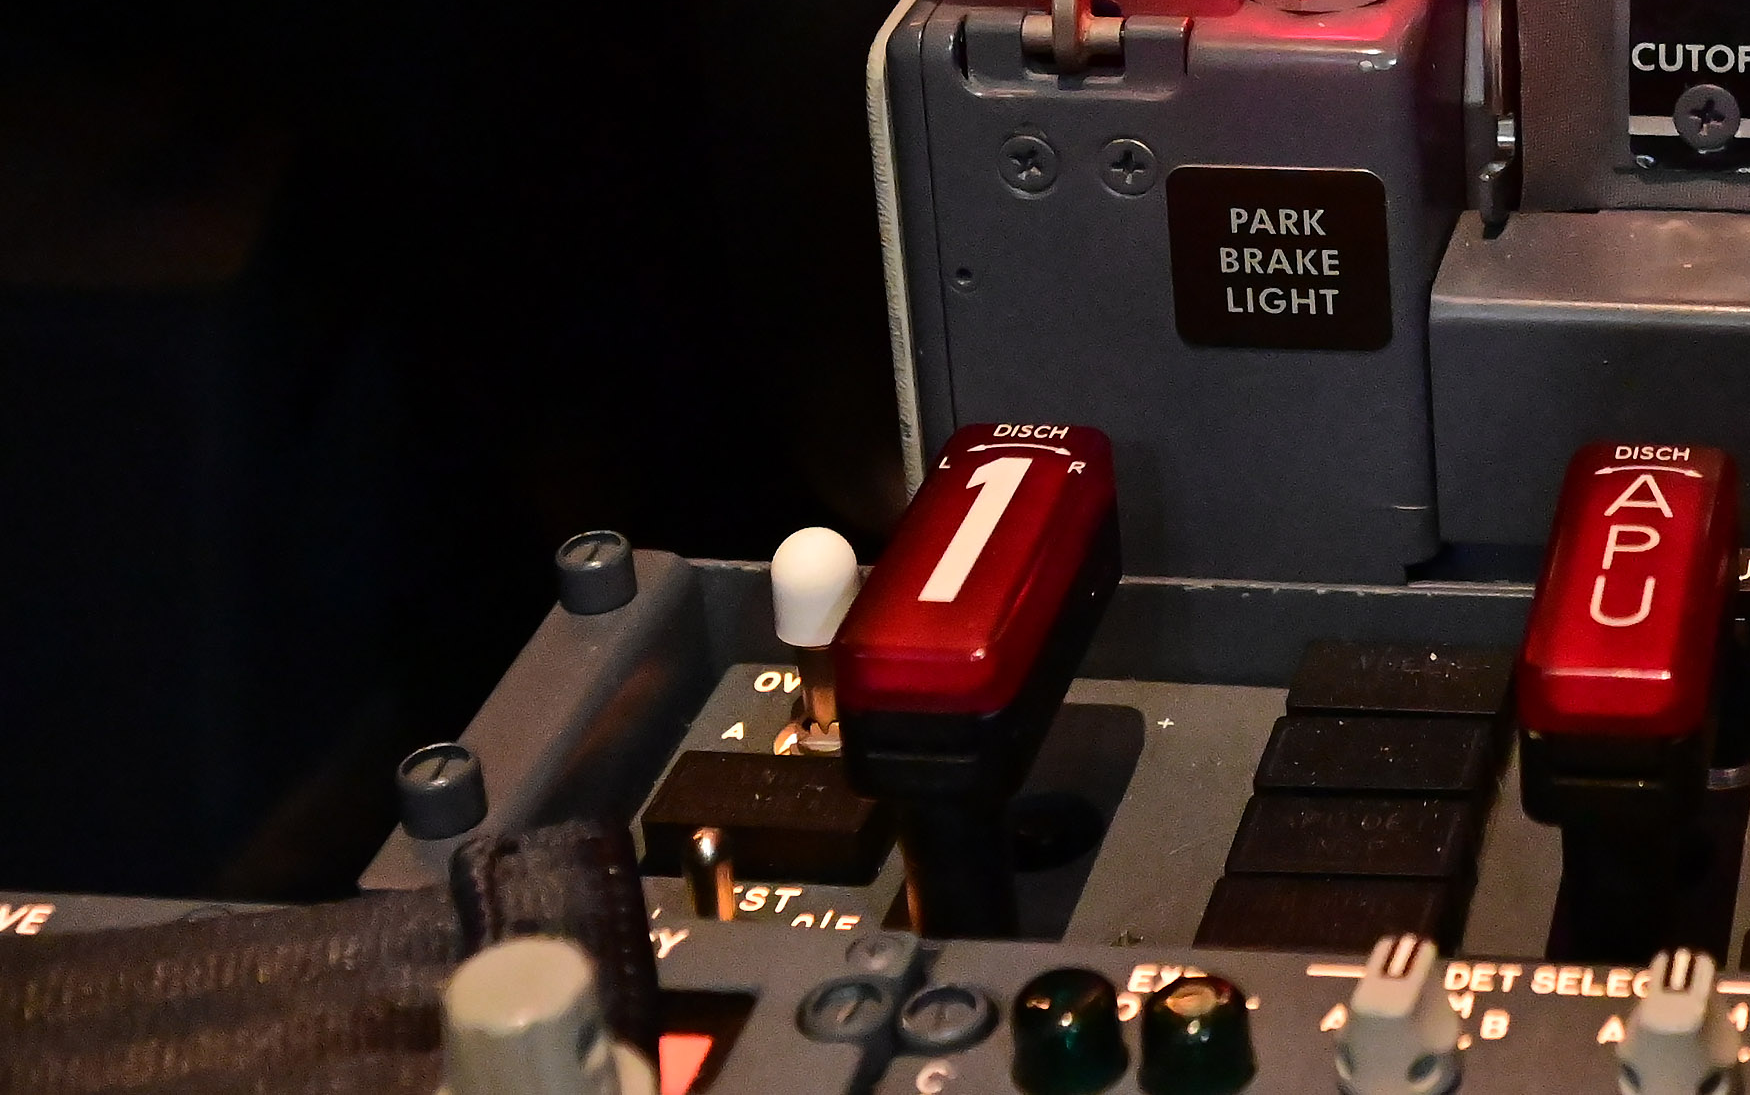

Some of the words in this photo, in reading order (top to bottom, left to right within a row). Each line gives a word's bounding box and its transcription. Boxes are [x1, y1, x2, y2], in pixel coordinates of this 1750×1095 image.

[1230, 207, 1327, 236] PARK
[1219, 247, 1340, 276] BRAKE
[1226, 287, 1340, 315] LIGHT
[993, 424, 1069, 440] DISCH
[939, 457, 950, 470] L
[1067, 461, 1086, 474] R
[1615, 446, 1690, 462] DISCH
[917, 457, 1033, 602] 1
[1589, 474, 1673, 627] APU
[721, 721, 744, 740] A
[1444, 962, 1523, 993] DET
[1480, 1009, 1511, 1040] B
[1597, 1015, 1626, 1044] A
